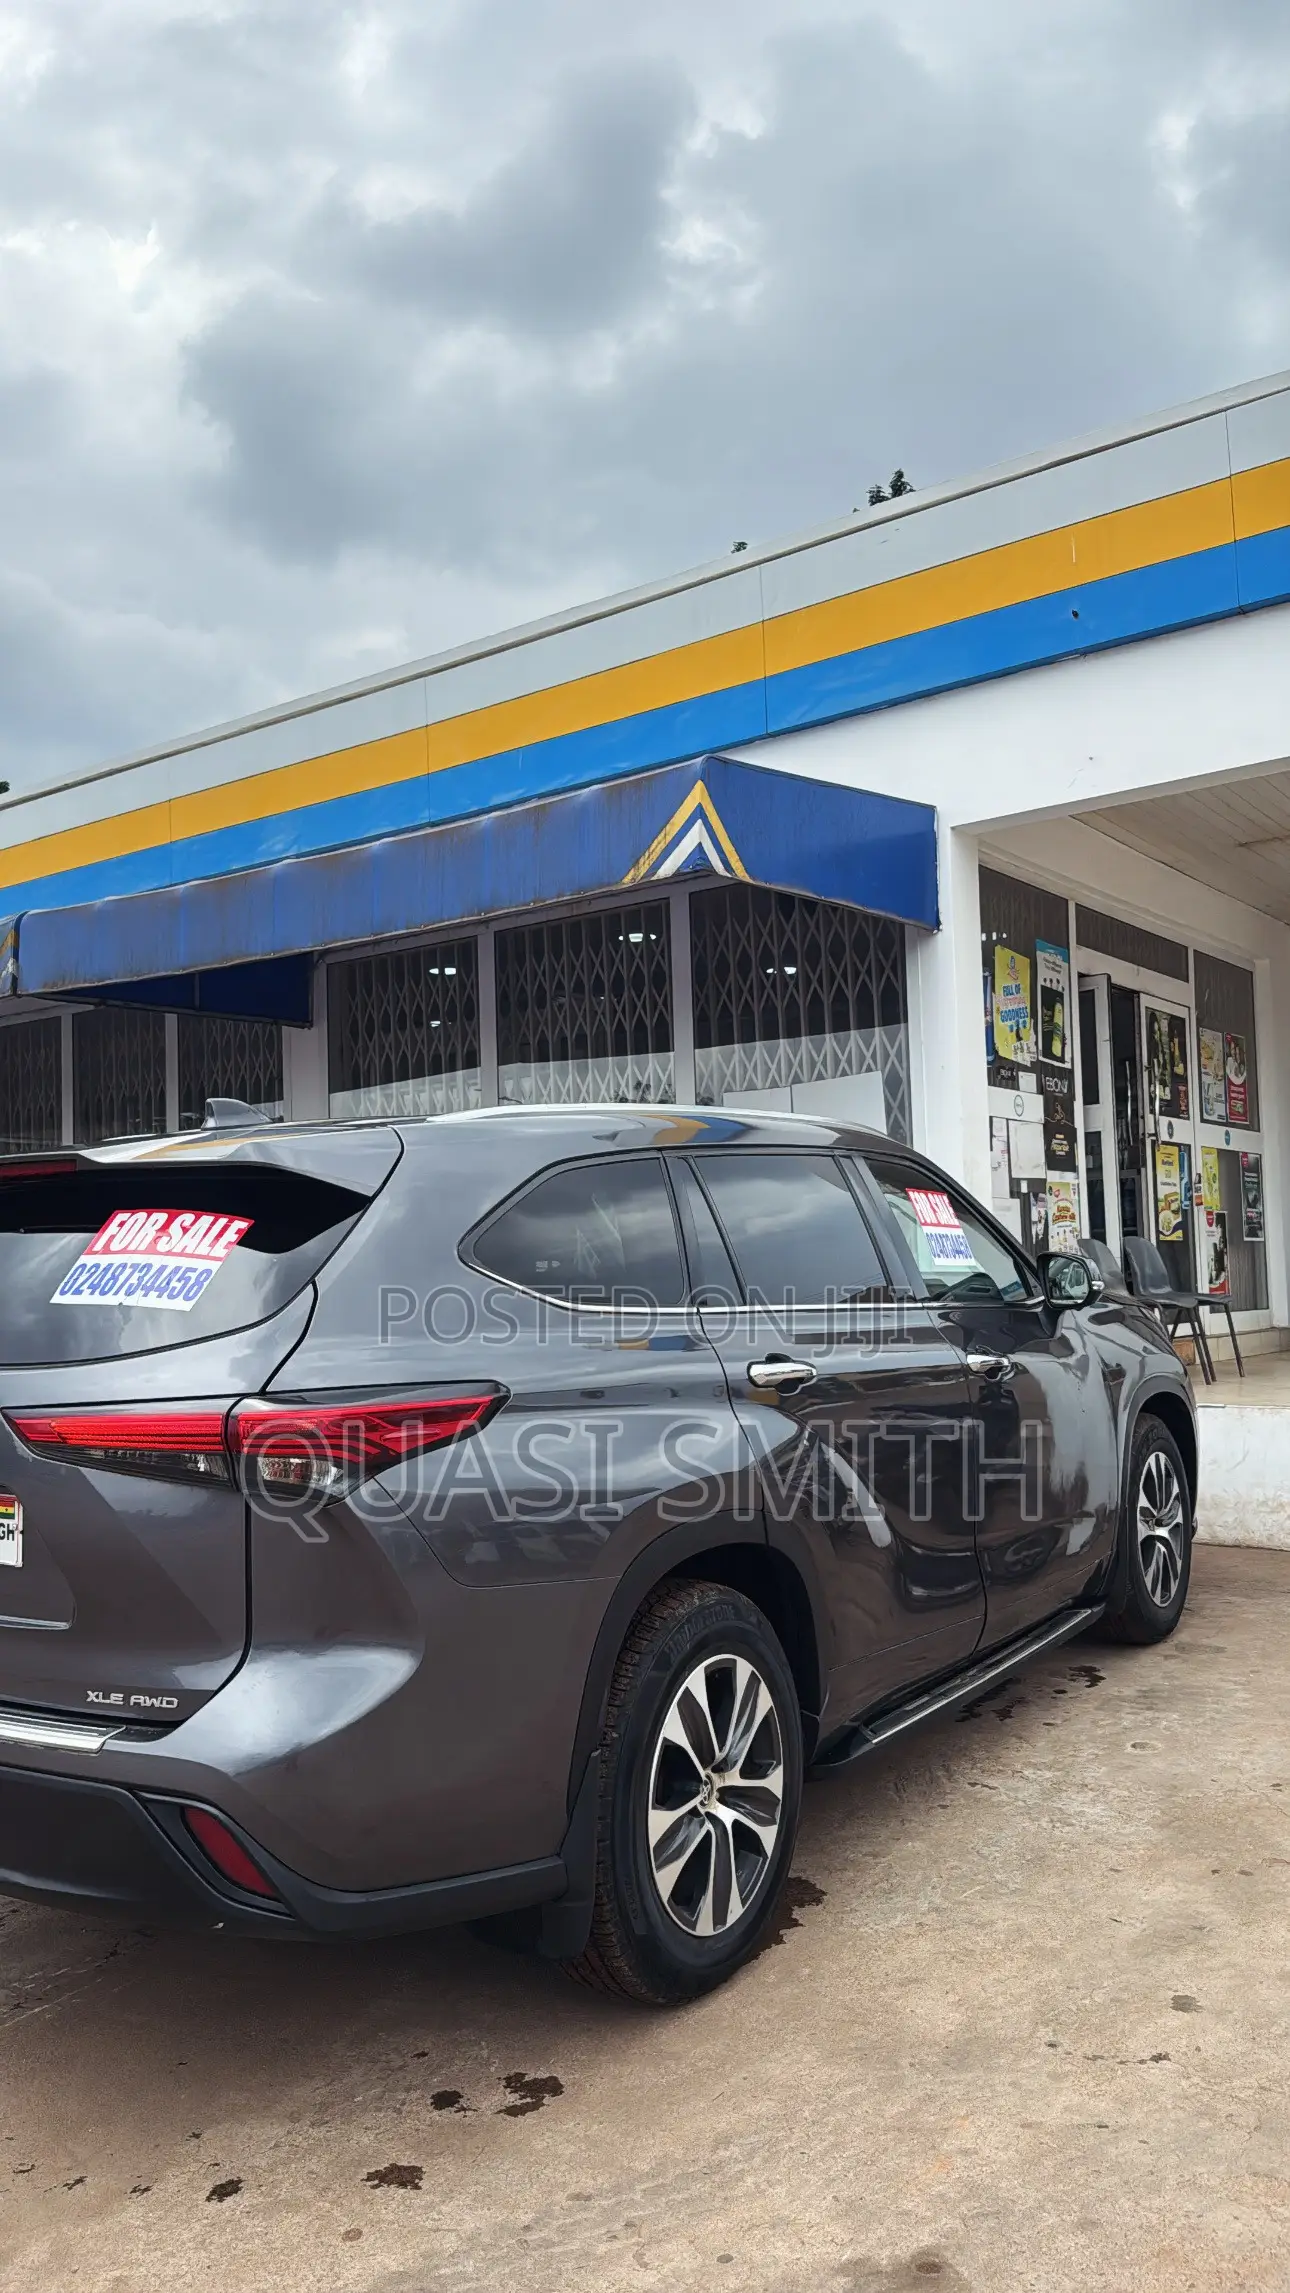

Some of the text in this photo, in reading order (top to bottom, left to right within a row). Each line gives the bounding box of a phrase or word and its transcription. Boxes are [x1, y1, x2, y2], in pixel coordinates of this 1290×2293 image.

[1003, 985, 1014, 997] FULL
[1000, 1006, 1028, 1023] GOODNESS
[908, 1191, 960, 1226] FOR SALE
[92, 1212, 250, 1258] FOR SALE
[59, 1262, 213, 1302] 0248734458
[86, 1690, 178, 1709] XLE AWD
